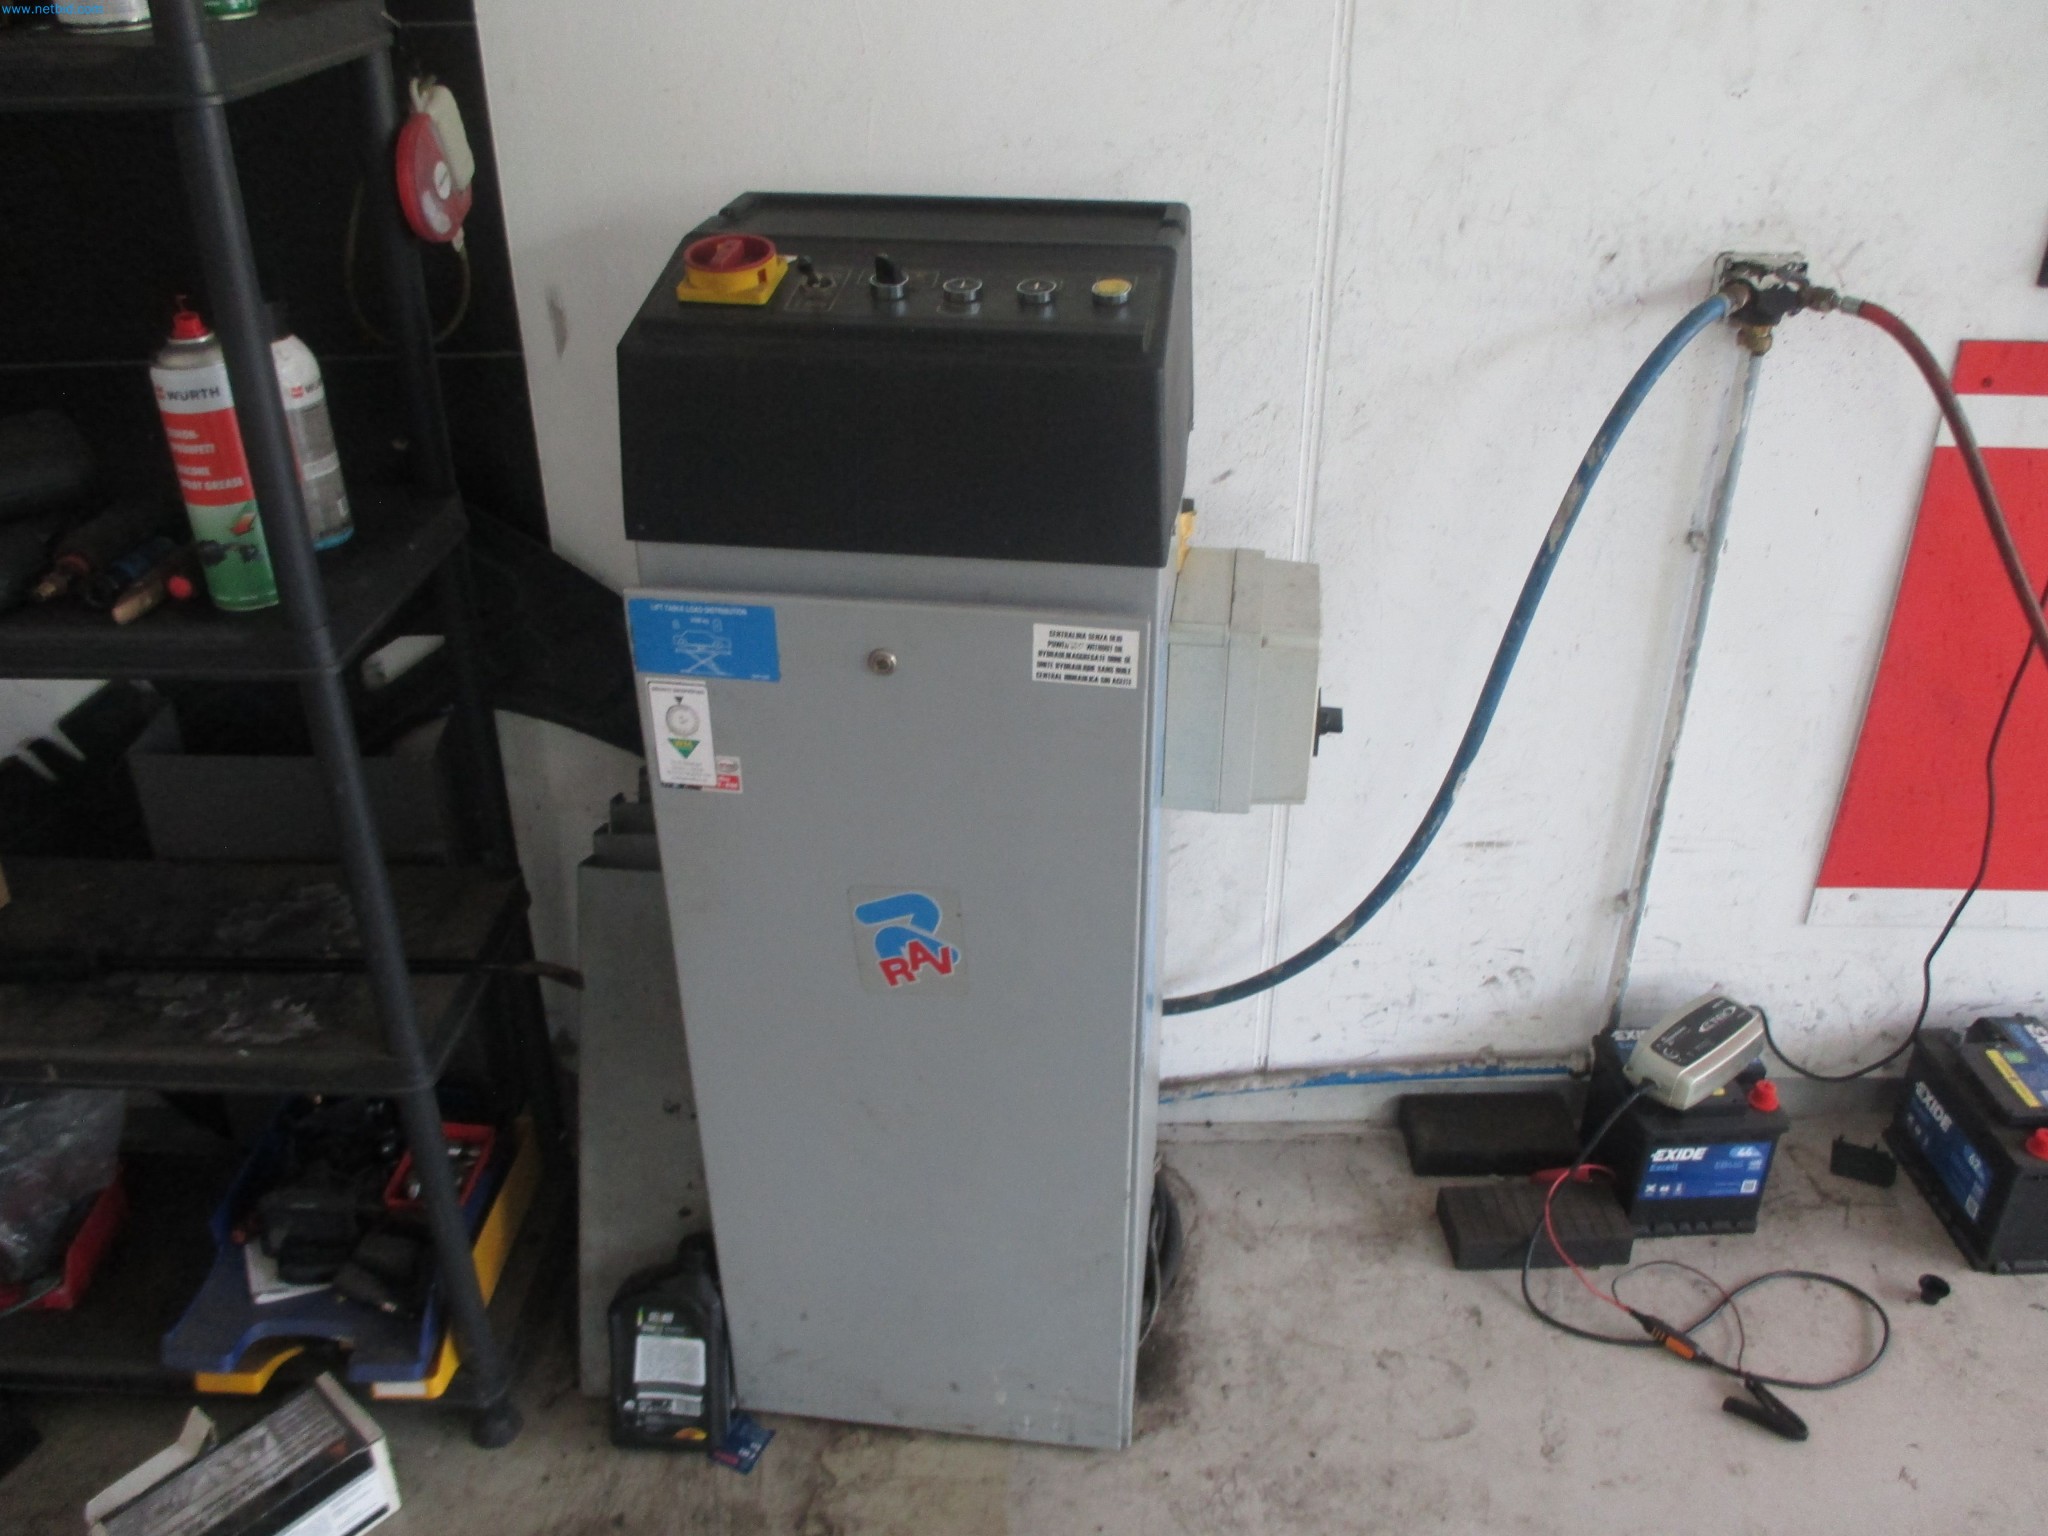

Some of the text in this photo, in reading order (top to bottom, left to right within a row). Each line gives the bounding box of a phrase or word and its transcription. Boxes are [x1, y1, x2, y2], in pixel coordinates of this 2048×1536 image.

[878, 939, 954, 987] RAV
[1915, 1080, 1952, 1133] EXIDE
[1650, 1147, 1709, 1162] EXIDE
